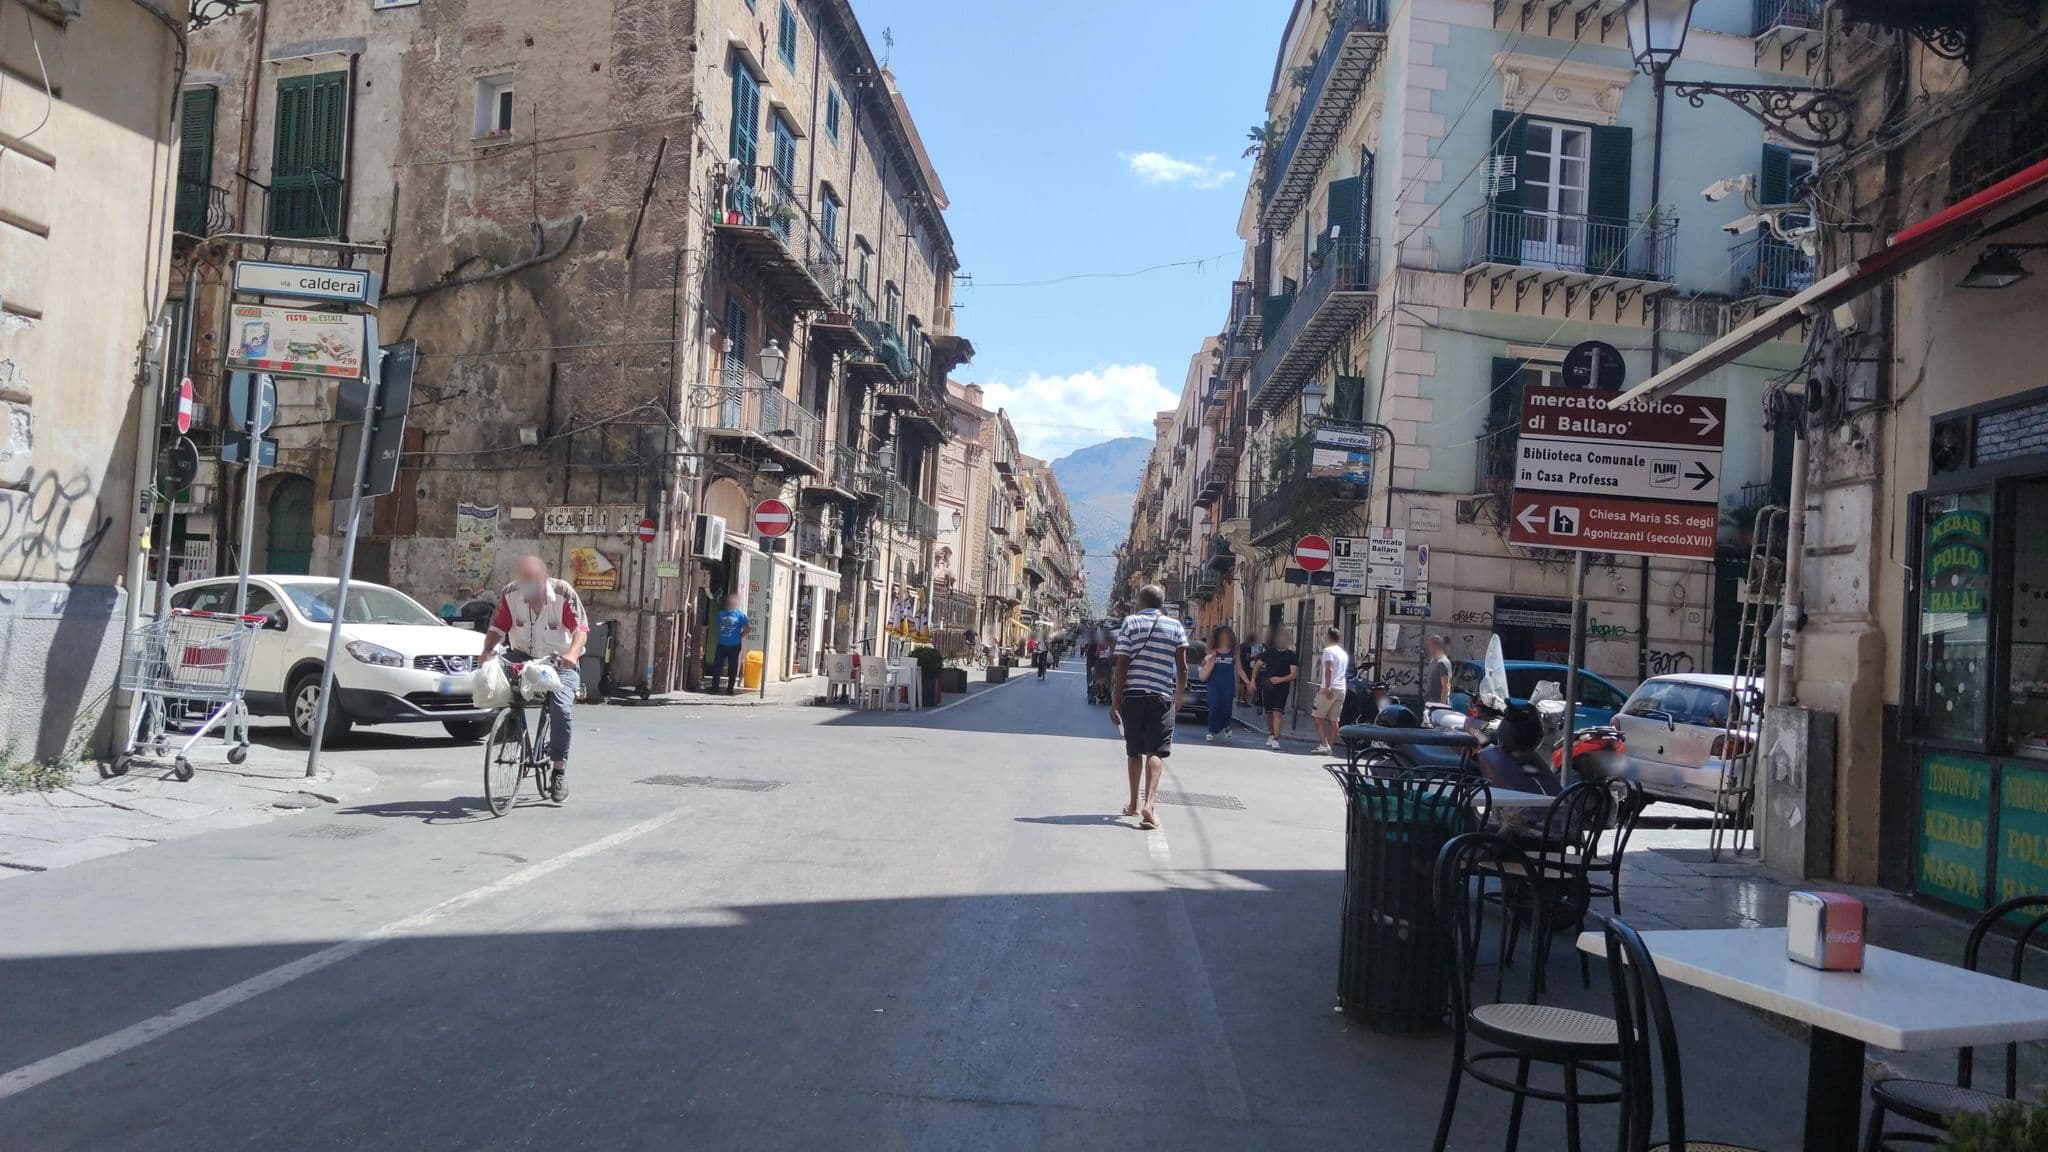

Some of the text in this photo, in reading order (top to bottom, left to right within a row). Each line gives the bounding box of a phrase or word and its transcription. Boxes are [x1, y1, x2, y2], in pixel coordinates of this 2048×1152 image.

[300, 278, 361, 294] calderai
[286, 314, 307, 322] FESTA
[1530, 394, 1685, 416] mercato storico
[1528, 415, 1545, 430] di
[1338, 436, 1369, 445] ponticello
[1523, 448, 1646, 467] Biblioteca Comunale
[1521, 469, 1618, 487] in Casa Professa
[1589, 508, 1714, 530] Chiesa Maria SS. degli
[1372, 538, 1403, 546] mercato
[1583, 527, 1712, 548] Agonizzanti (secoloXVII)
[1337, 541, 1350, 556] T
[1933, 547, 1978, 575] POLLO
[1932, 590, 1980, 610] HALAL
[1925, 809, 1982, 849] KEBAB
